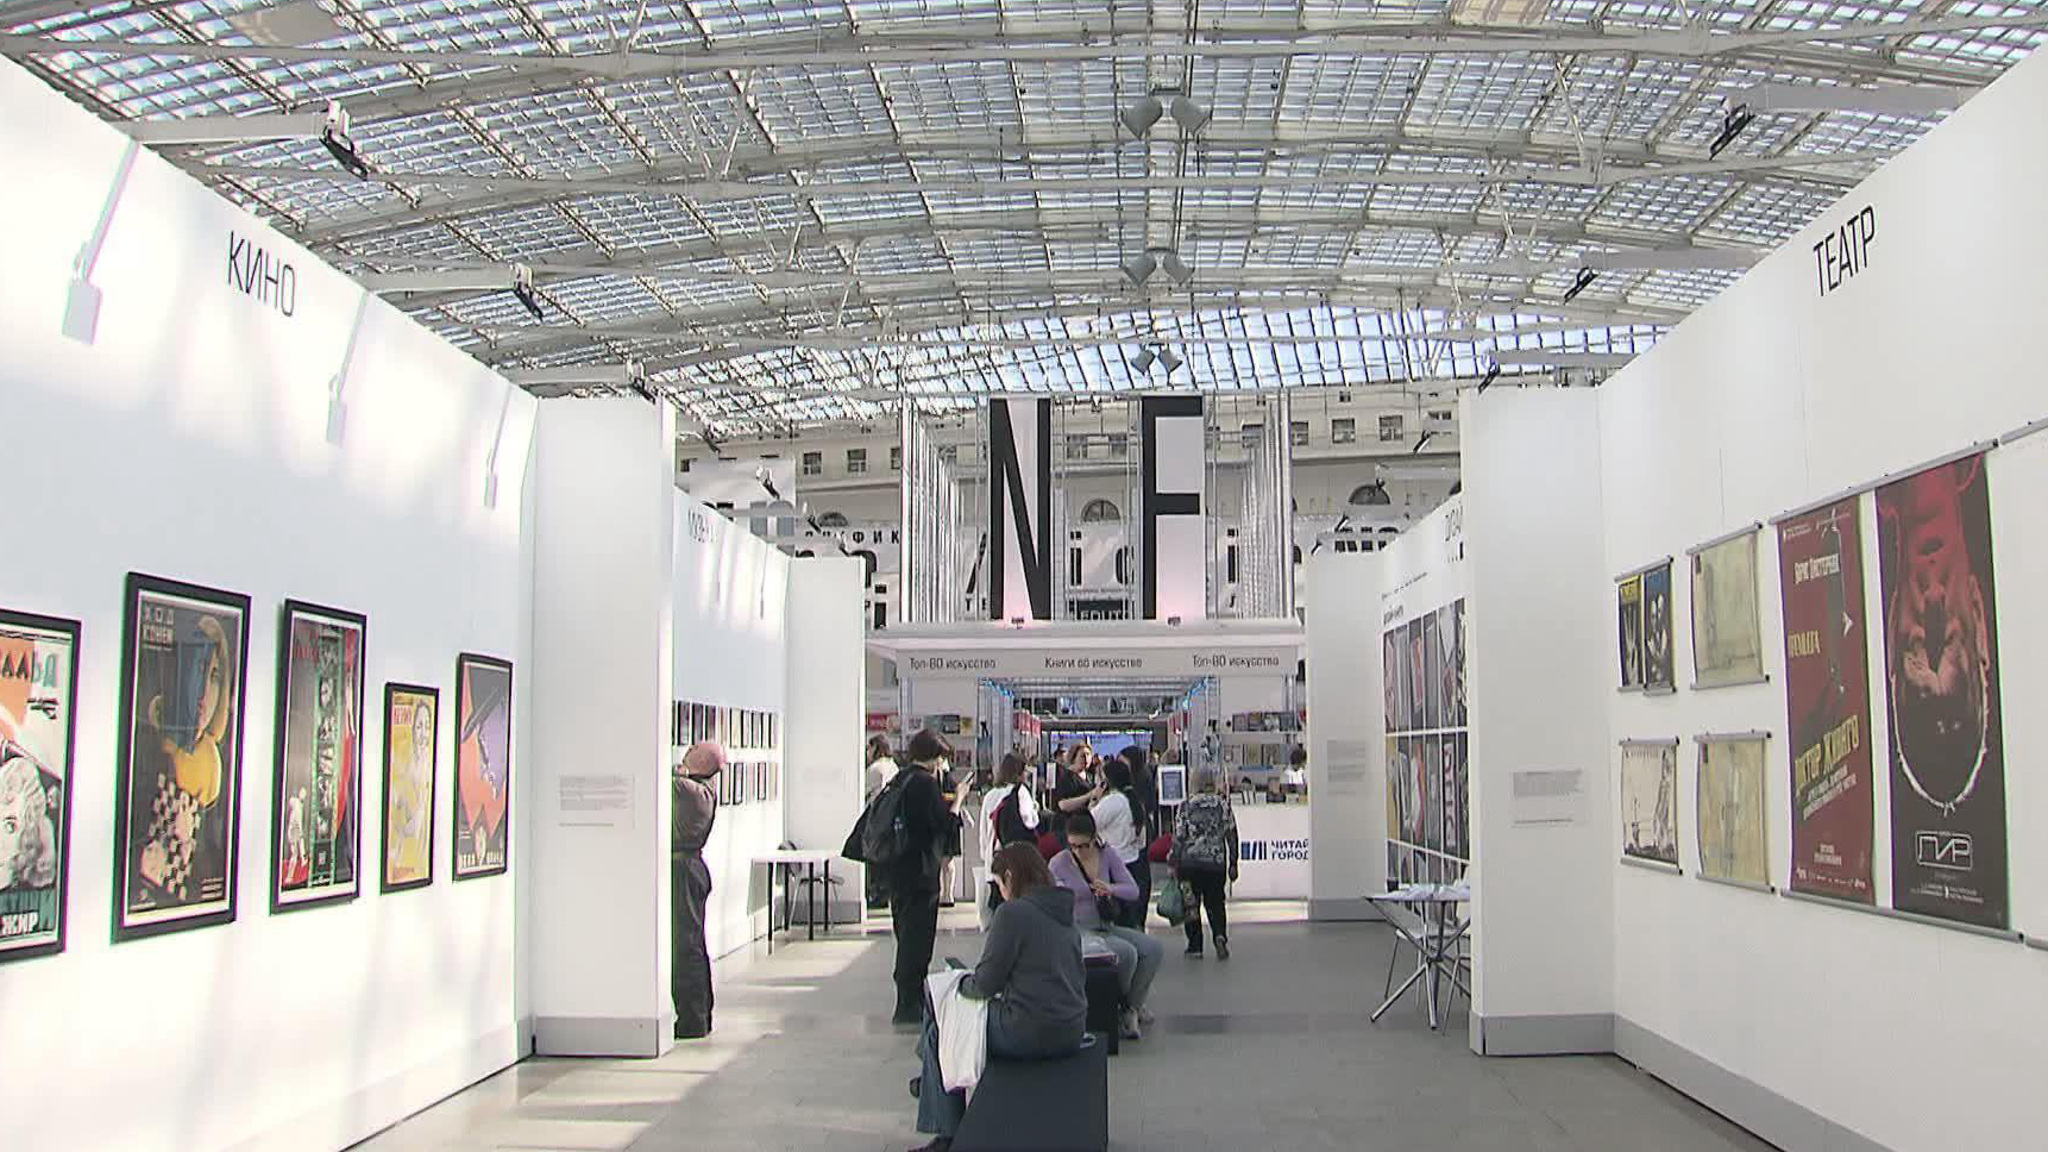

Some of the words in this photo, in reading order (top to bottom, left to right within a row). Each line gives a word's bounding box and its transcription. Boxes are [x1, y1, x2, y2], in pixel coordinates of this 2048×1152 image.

[227, 230, 296, 318] КИНО
[1813, 205, 1875, 297] ТЕАТР
[1045, 658, 1076, 668] Книги
[1078, 657, 1090, 668] об
